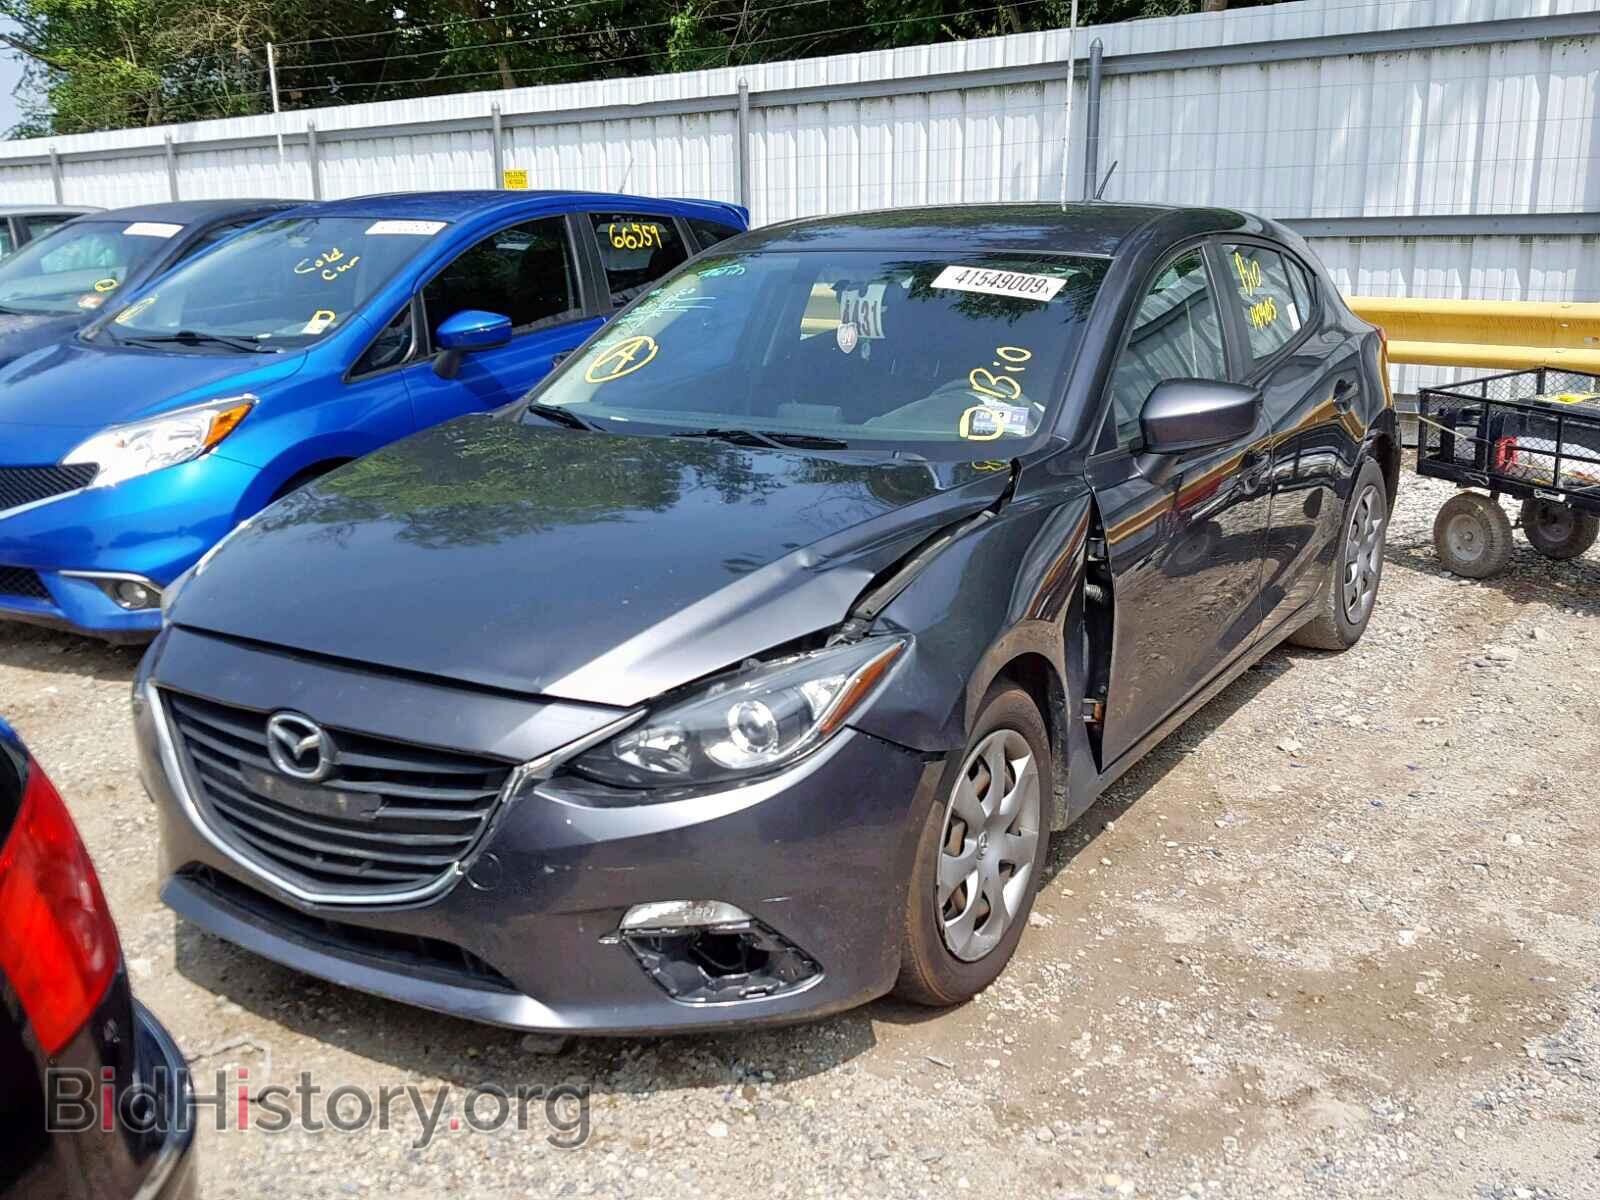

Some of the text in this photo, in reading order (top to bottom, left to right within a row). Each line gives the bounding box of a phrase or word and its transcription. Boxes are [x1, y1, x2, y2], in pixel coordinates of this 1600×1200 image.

[609, 223, 662, 249] 66559
[954, 269, 1048, 294] 41549009
[969, 346, 1032, 400] Bio
